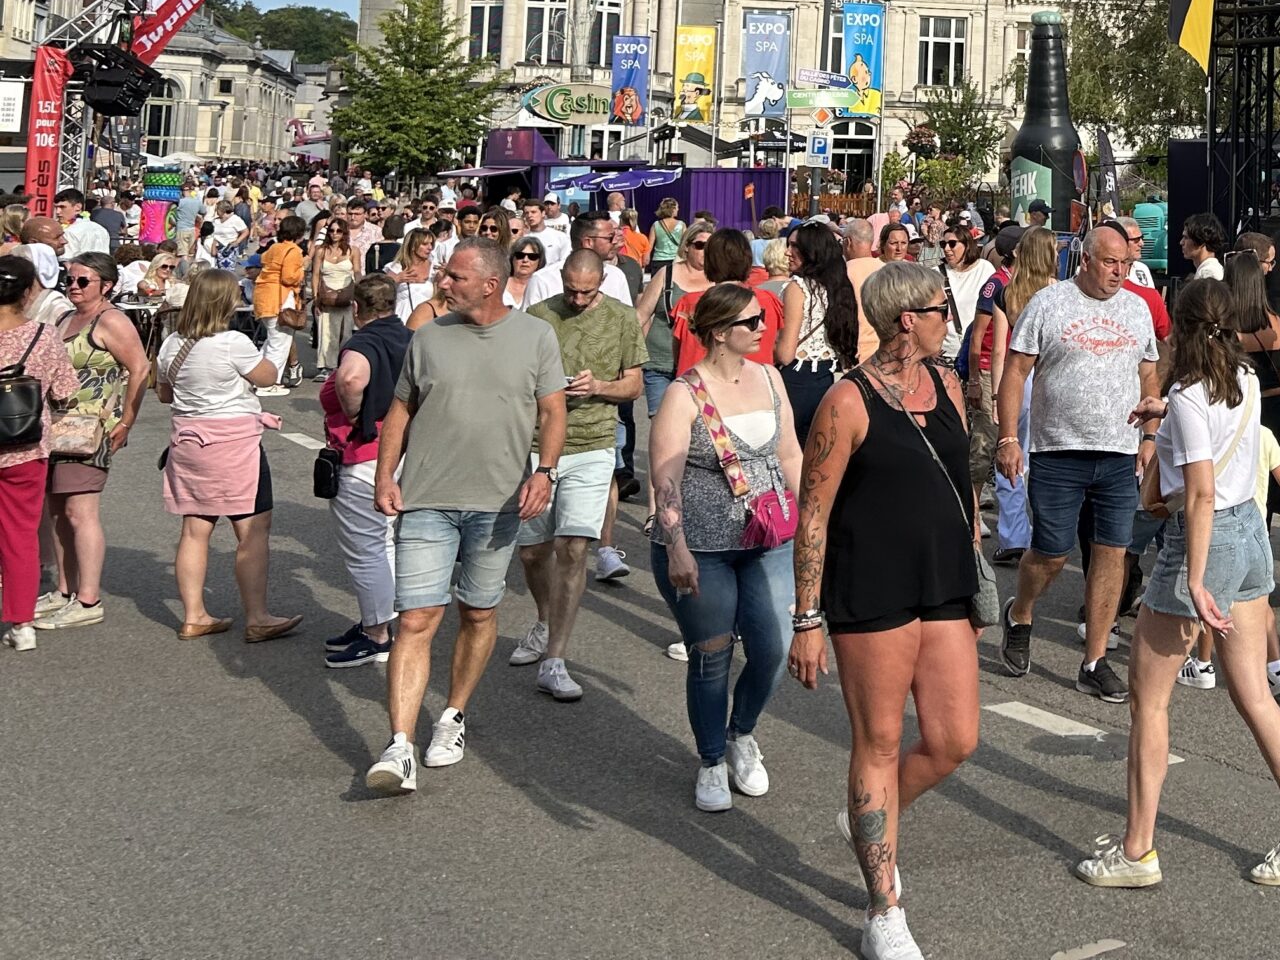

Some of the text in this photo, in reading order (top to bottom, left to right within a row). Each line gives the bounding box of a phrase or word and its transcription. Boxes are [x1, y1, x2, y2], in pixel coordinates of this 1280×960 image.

[846, 13, 881, 27] EXPO
[749, 23, 785, 35] EXPO
[679, 34, 713, 46] EXPO
[854, 33, 874, 45] SPA
[615, 43, 648, 54] EXPO
[755, 41, 779, 52] SPA
[685, 51, 706, 62] SPA
[621, 60, 641, 69] SPA
[545, 88, 611, 120] Casin
[36, 119, 57, 128] pour
[36, 133, 57, 147] 10€
[814, 138, 825, 153] P
